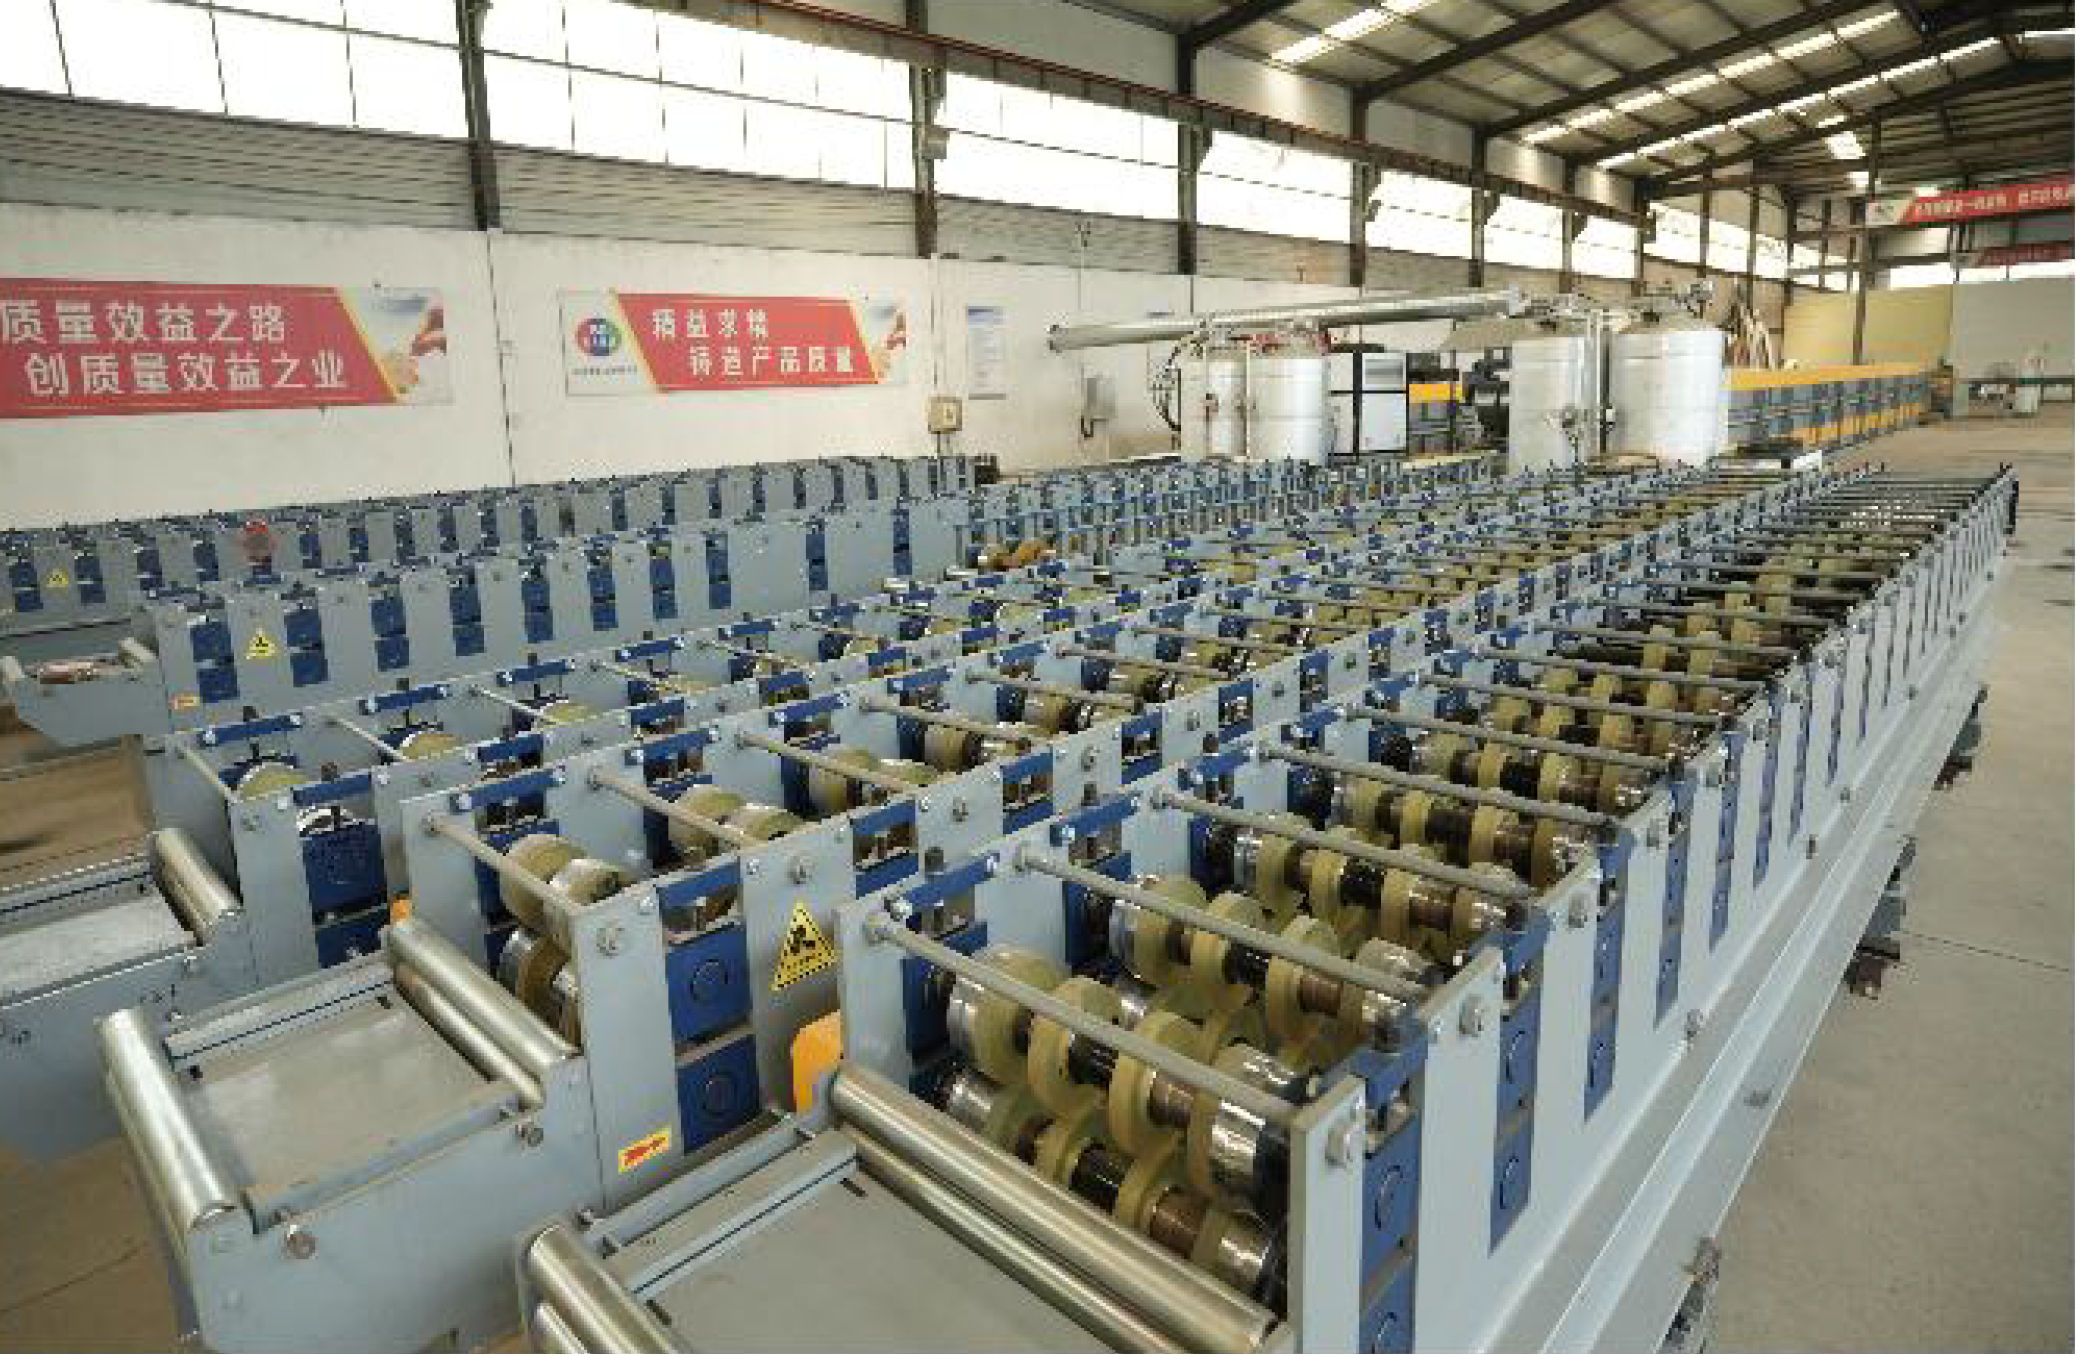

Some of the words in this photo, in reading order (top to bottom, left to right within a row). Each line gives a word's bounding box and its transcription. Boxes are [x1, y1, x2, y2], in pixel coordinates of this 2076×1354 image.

[0, 300, 285, 344] 质量效益之路
[24, 350, 345, 396] 创质量效益之业
